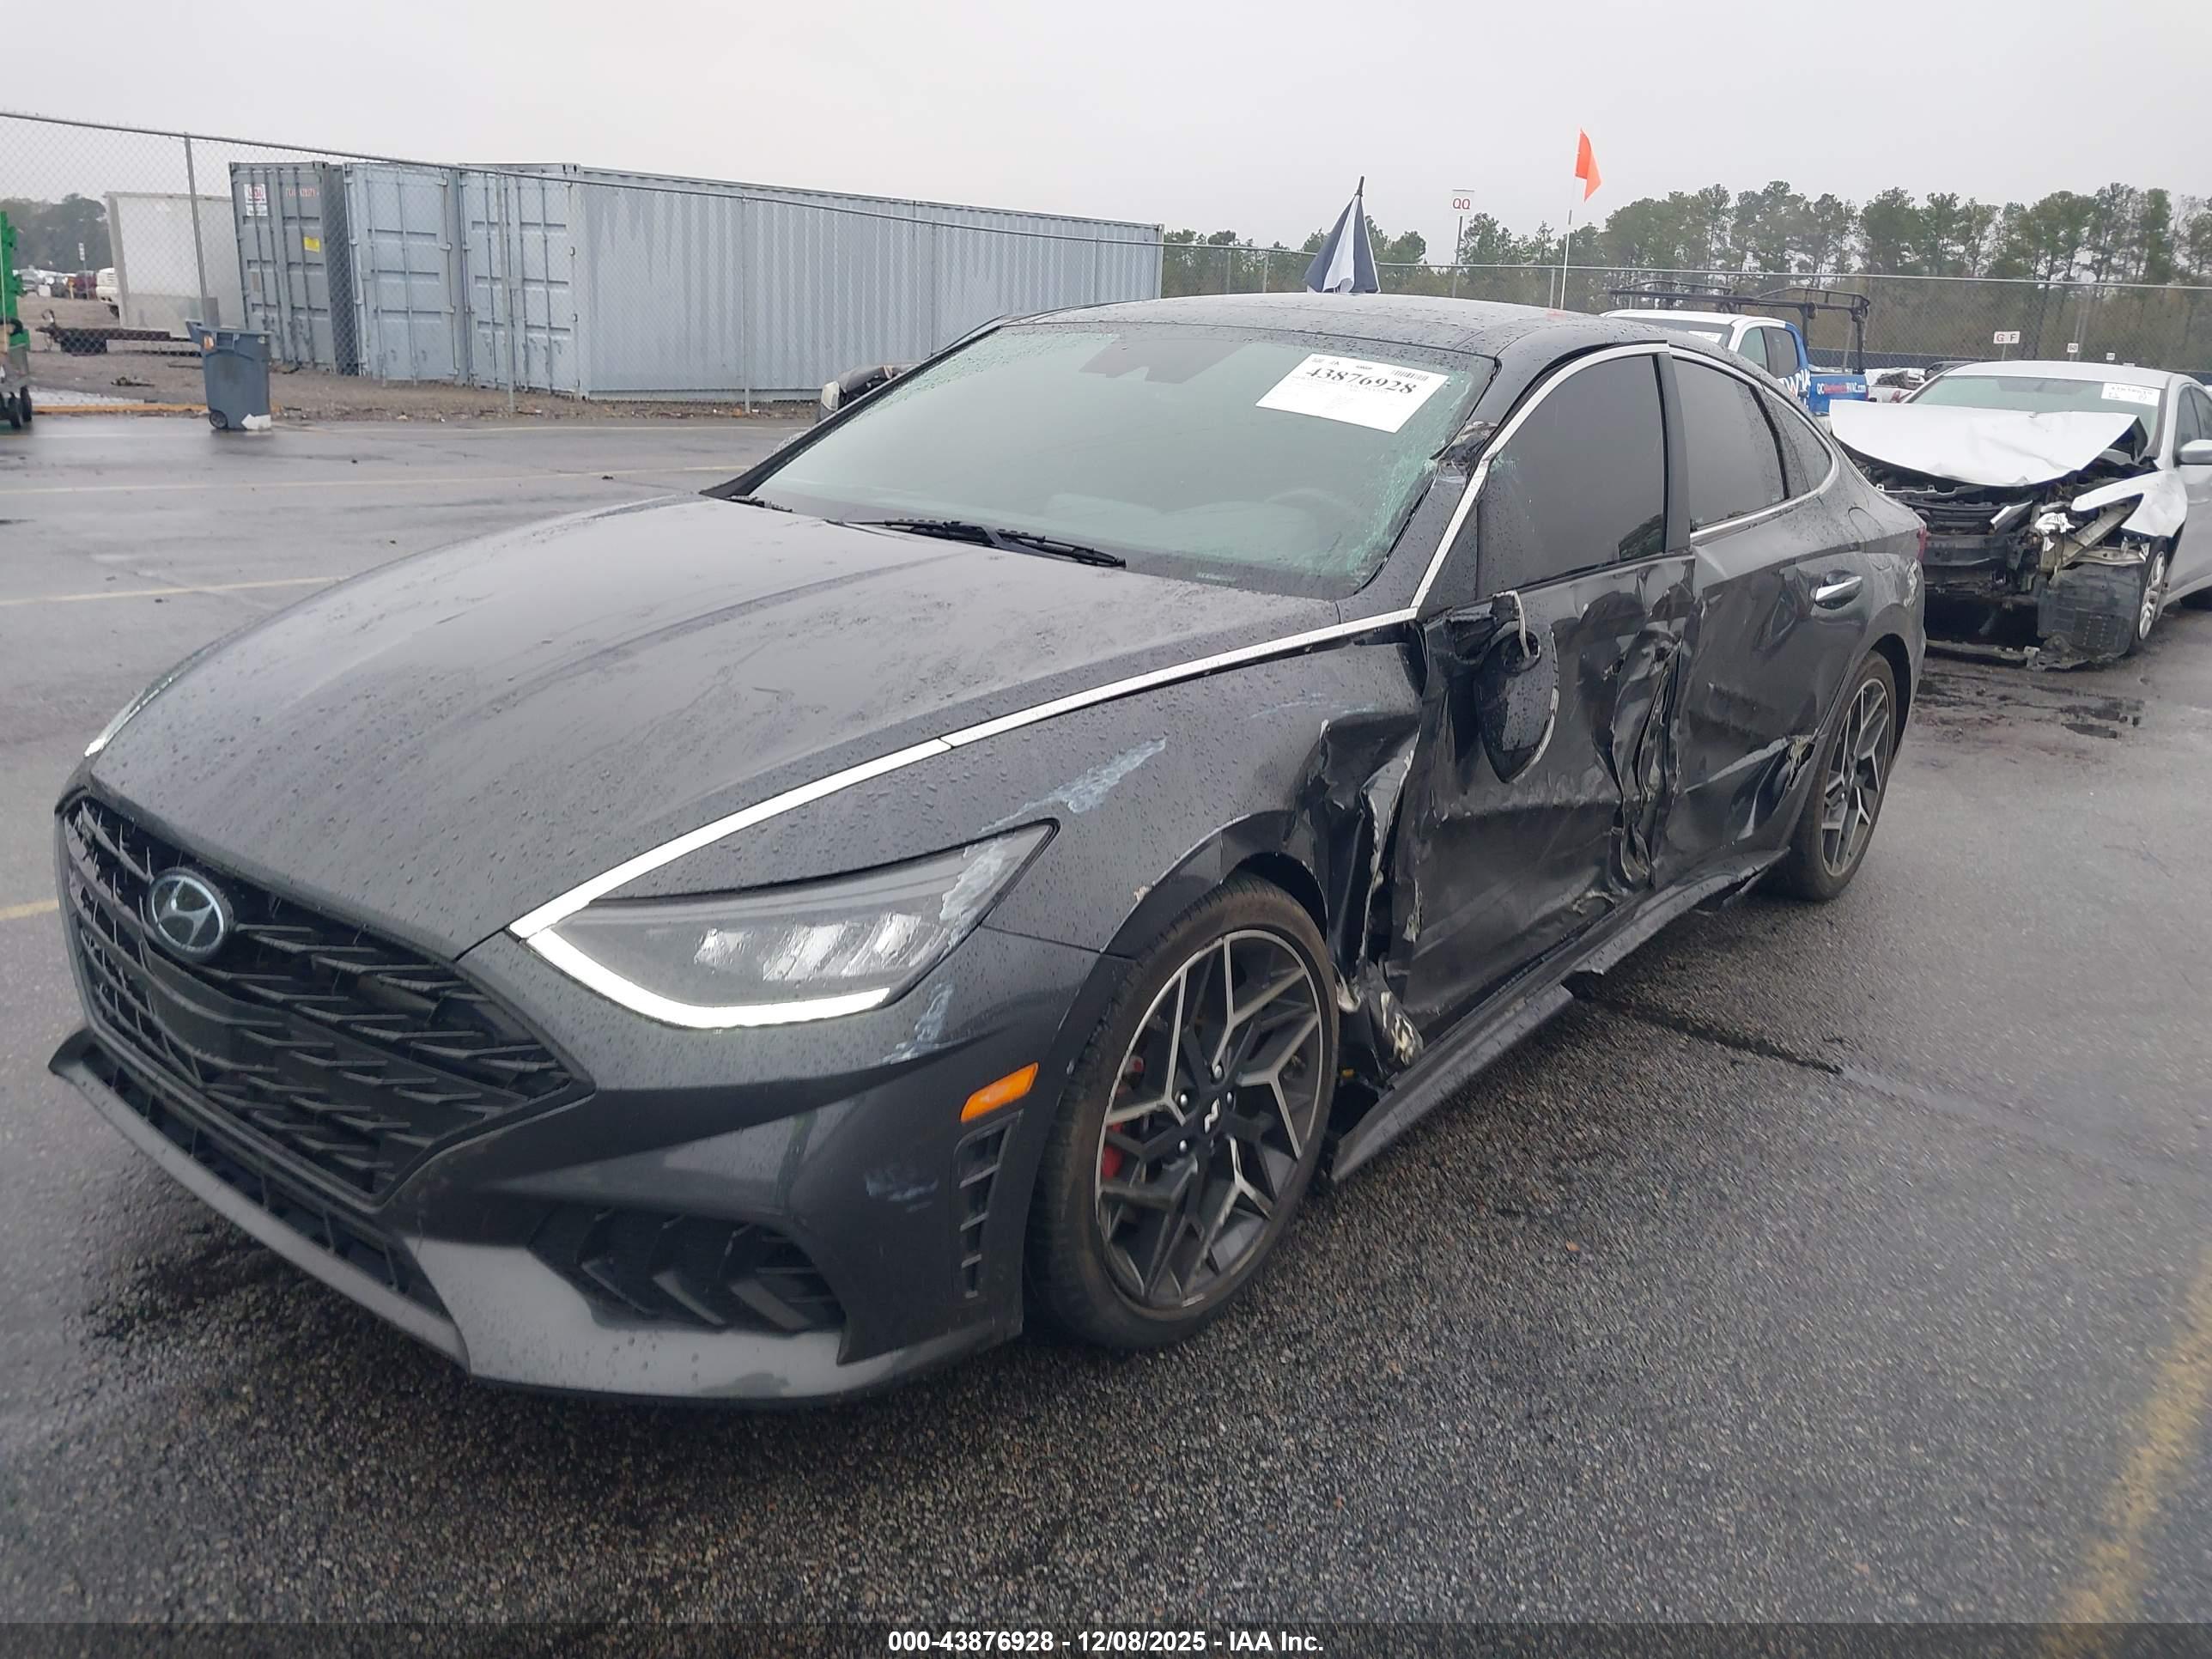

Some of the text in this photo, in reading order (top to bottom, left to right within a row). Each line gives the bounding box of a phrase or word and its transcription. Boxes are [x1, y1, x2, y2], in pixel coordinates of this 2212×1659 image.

[1452, 198, 1471, 210] QQ
[1996, 333, 2016, 343] G F
[1306, 367, 1417, 394] 43876928
